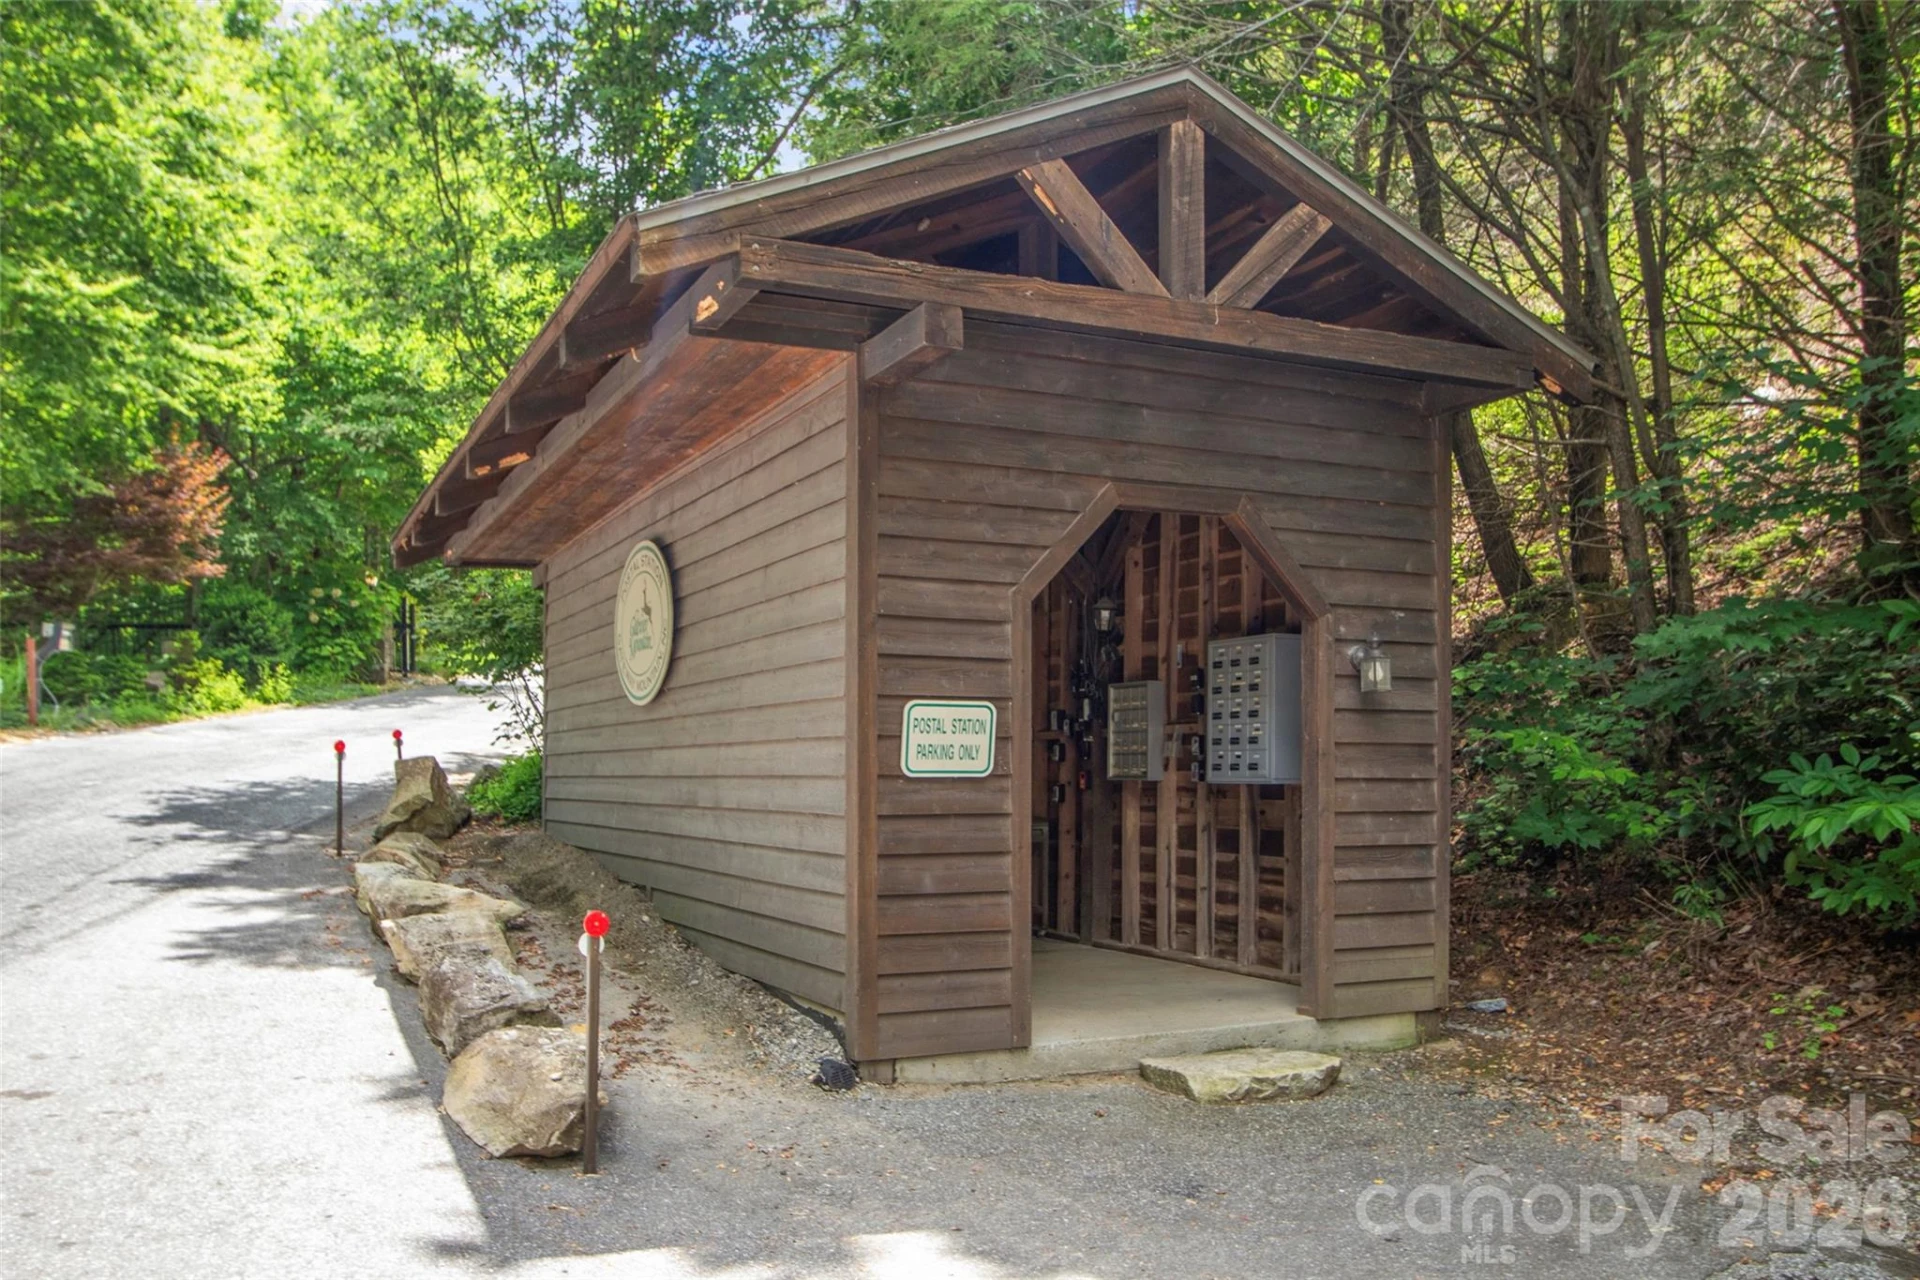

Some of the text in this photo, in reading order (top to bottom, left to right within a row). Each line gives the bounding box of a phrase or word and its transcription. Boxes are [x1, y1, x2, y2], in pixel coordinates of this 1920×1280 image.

[913, 717, 987, 735] POSTAL STATION
[916, 744, 981, 761] PARKING ONLY
